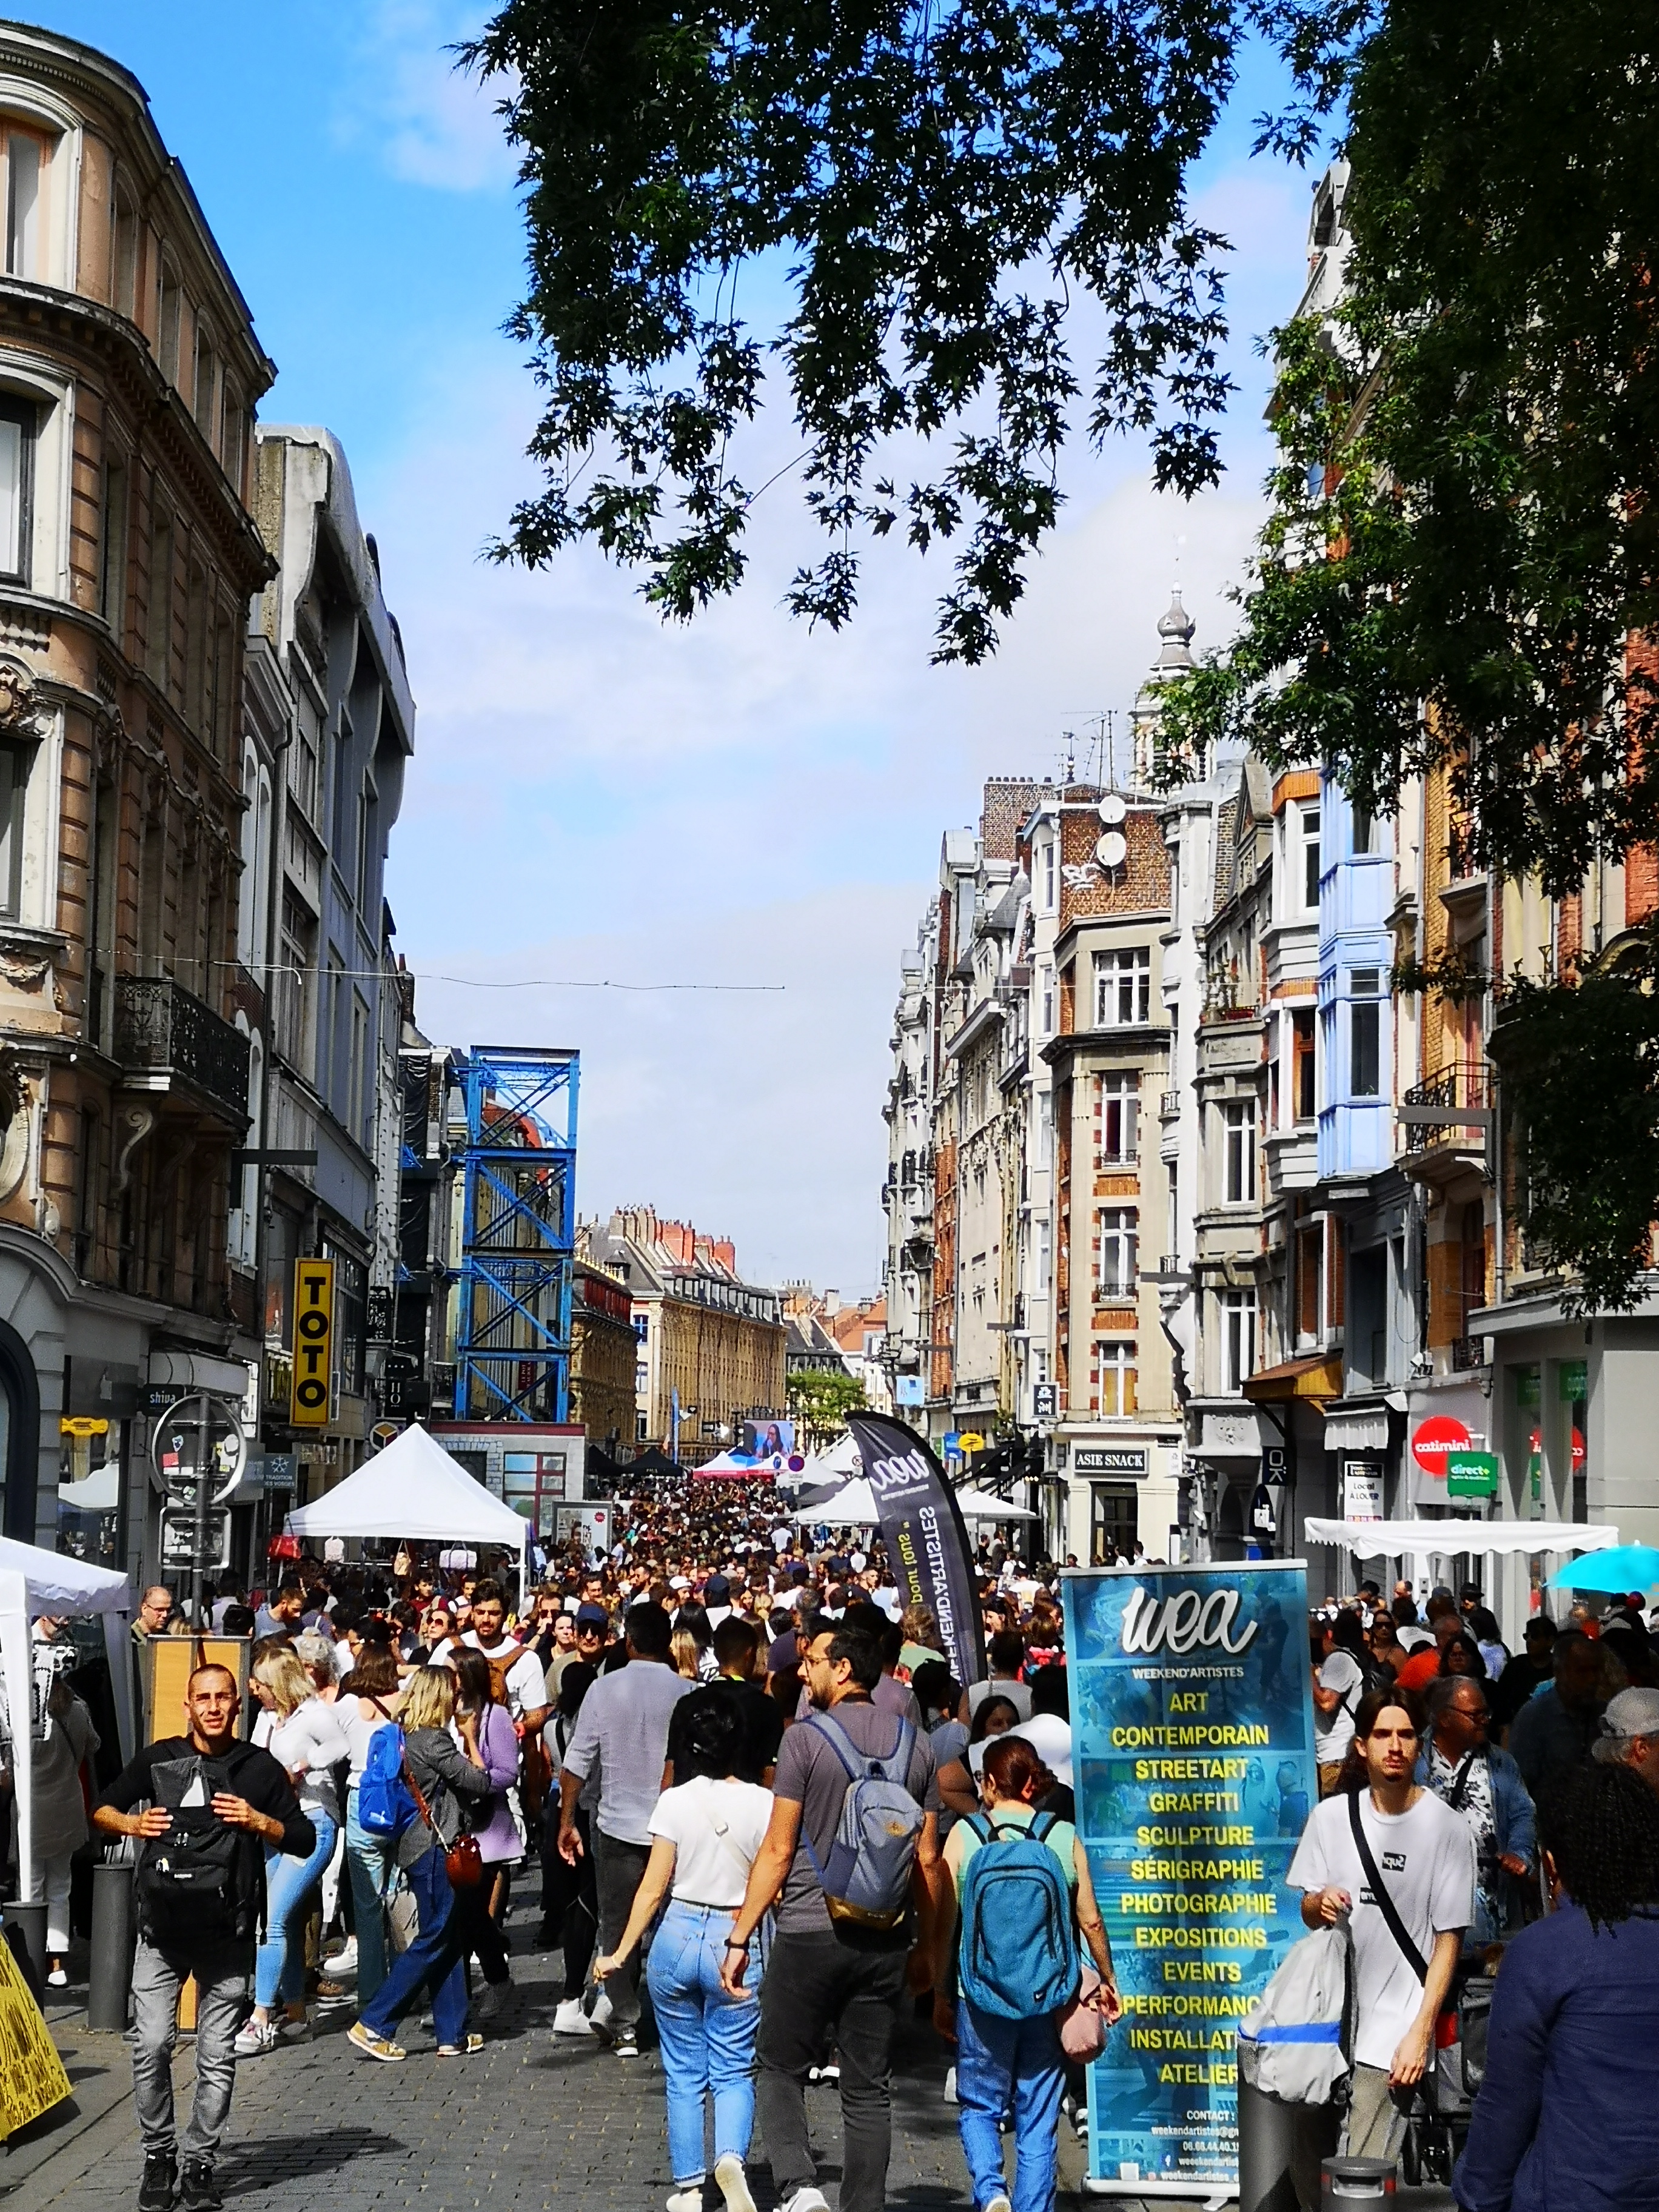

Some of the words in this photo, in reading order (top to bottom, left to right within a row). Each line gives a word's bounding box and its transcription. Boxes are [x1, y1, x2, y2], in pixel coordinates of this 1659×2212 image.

[297, 1276, 329, 1408] TOTO
[150, 1390, 176, 1404] shiva
[1415, 1439, 1470, 1452] catimini
[1077, 1453, 1103, 1466] ASIE
[1105, 1453, 1143, 1467] SNACK
[1122, 1587, 1258, 1654] wea
[1170, 1692, 1208, 1712] ART
[1112, 1725, 1269, 1746] CONTEMPORAIN
[1136, 1758, 1248, 1779] STREETART
[1150, 1792, 1239, 1812] GRAFFITI
[1137, 1826, 1255, 1846] SCULPTURE
[1131, 1856, 1264, 1880] SÉRIGRAPHIE
[1121, 1893, 1277, 1914] PHOTOGRAPHIE
[1136, 1927, 1267, 1948] EXPOSITIONS
[1164, 1962, 1242, 1982] EVENTS
[1161, 2064, 1238, 2085] ATELIER
[1187, 2110, 1229, 2121] CONTACT
